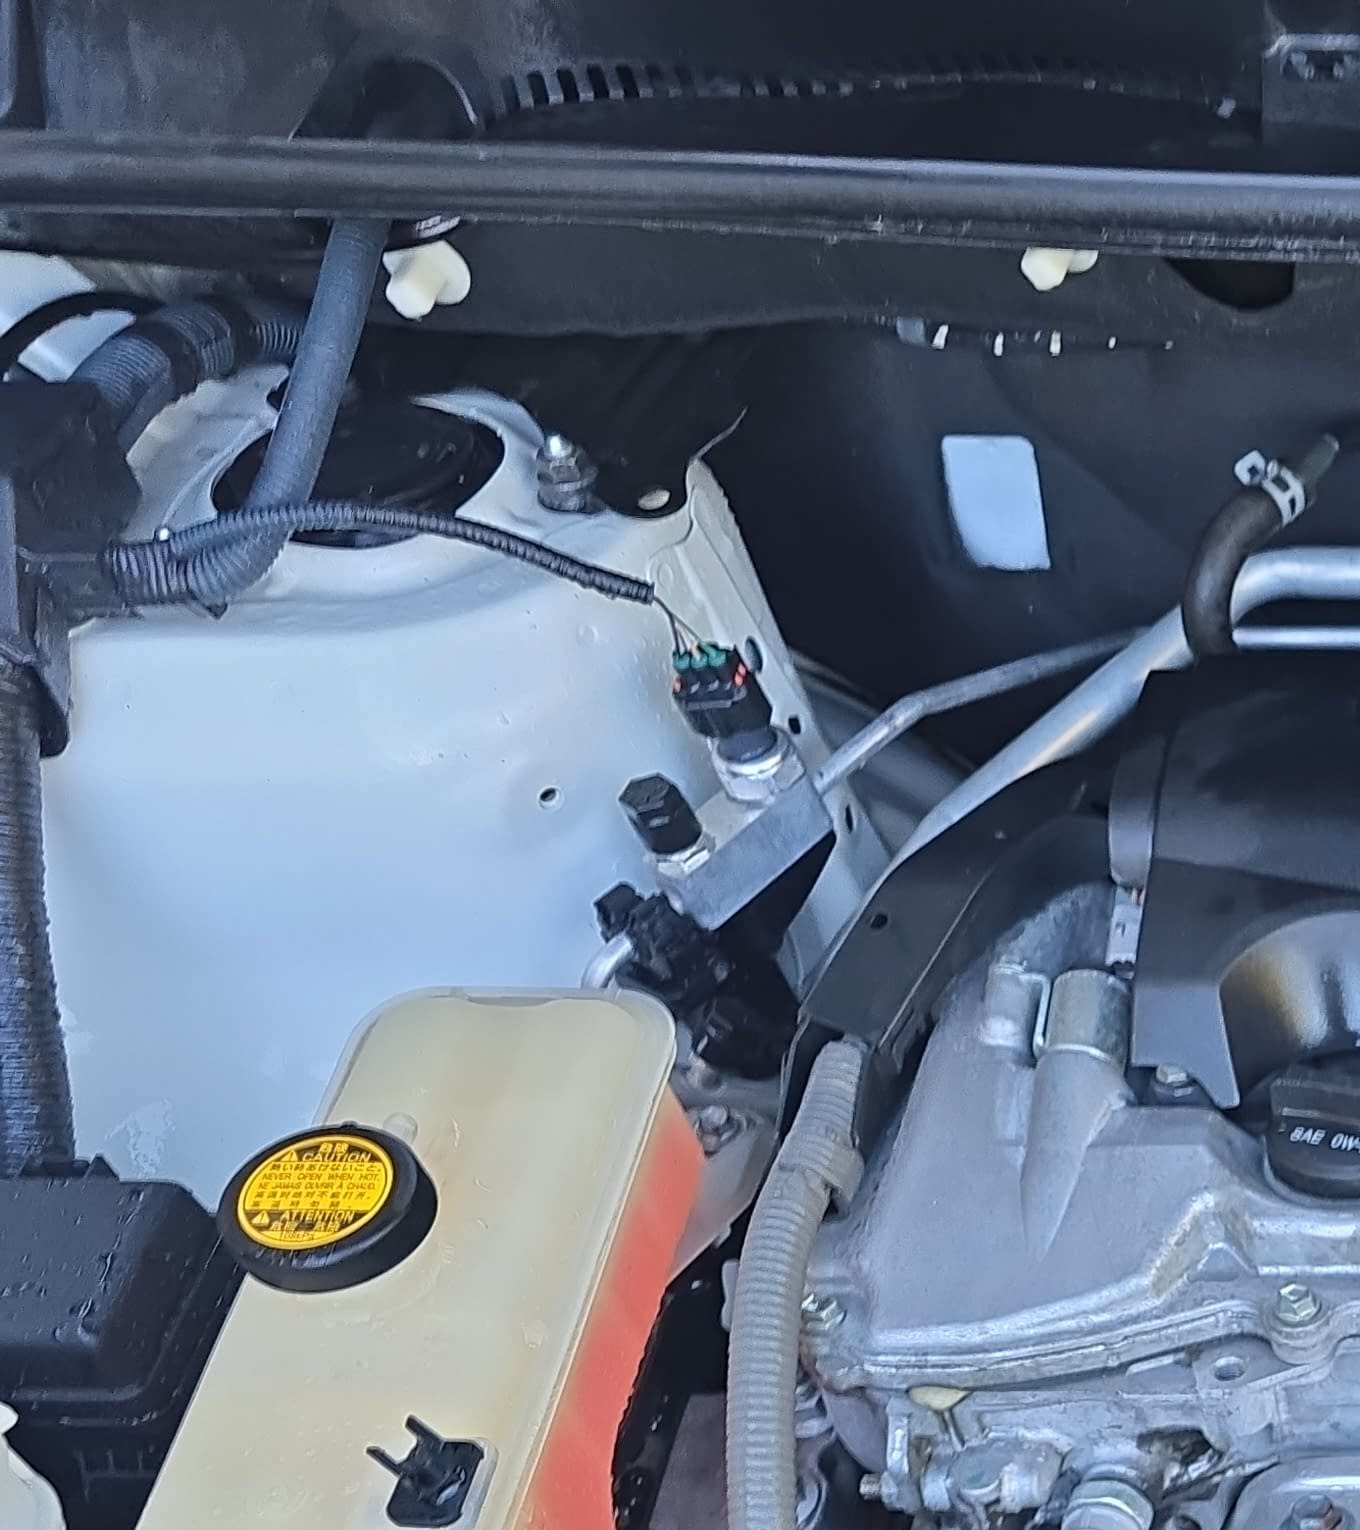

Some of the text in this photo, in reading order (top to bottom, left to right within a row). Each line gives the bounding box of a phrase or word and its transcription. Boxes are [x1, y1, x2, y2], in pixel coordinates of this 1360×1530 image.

[302, 1151, 372, 1163] CAUTION
[261, 1173, 293, 1181] NEVER
[297, 1173, 323, 1181] OPEN
[327, 1173, 353, 1181] WHEN
[280, 1210, 356, 1224] ATTENTION
